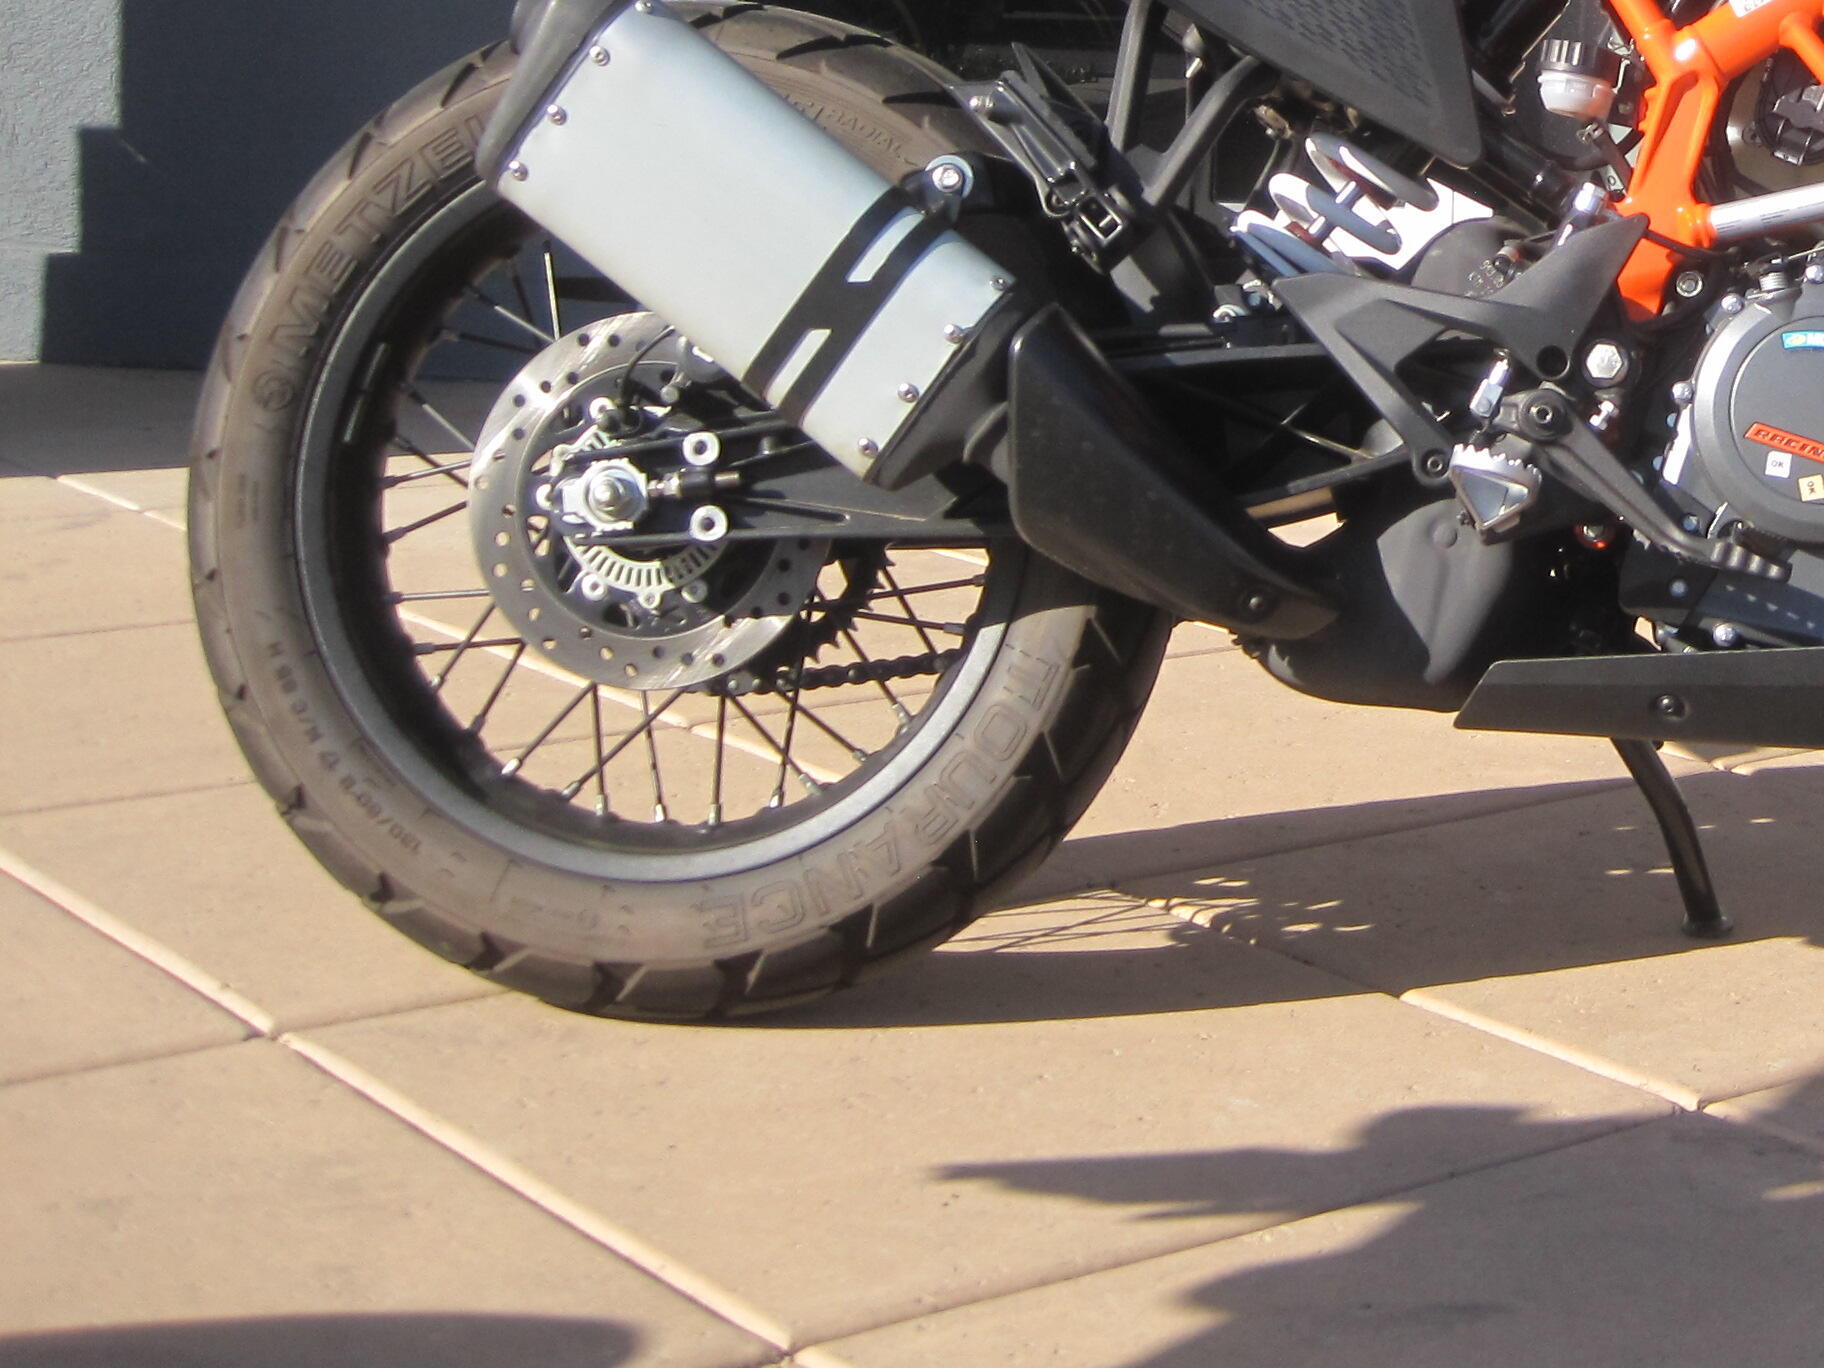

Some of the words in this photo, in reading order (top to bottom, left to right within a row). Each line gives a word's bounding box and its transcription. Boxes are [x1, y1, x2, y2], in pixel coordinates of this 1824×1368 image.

[268, 114, 486, 360] METZE
[1770, 458, 1785, 469] OK
[701, 640, 1066, 950] TOURANCE
